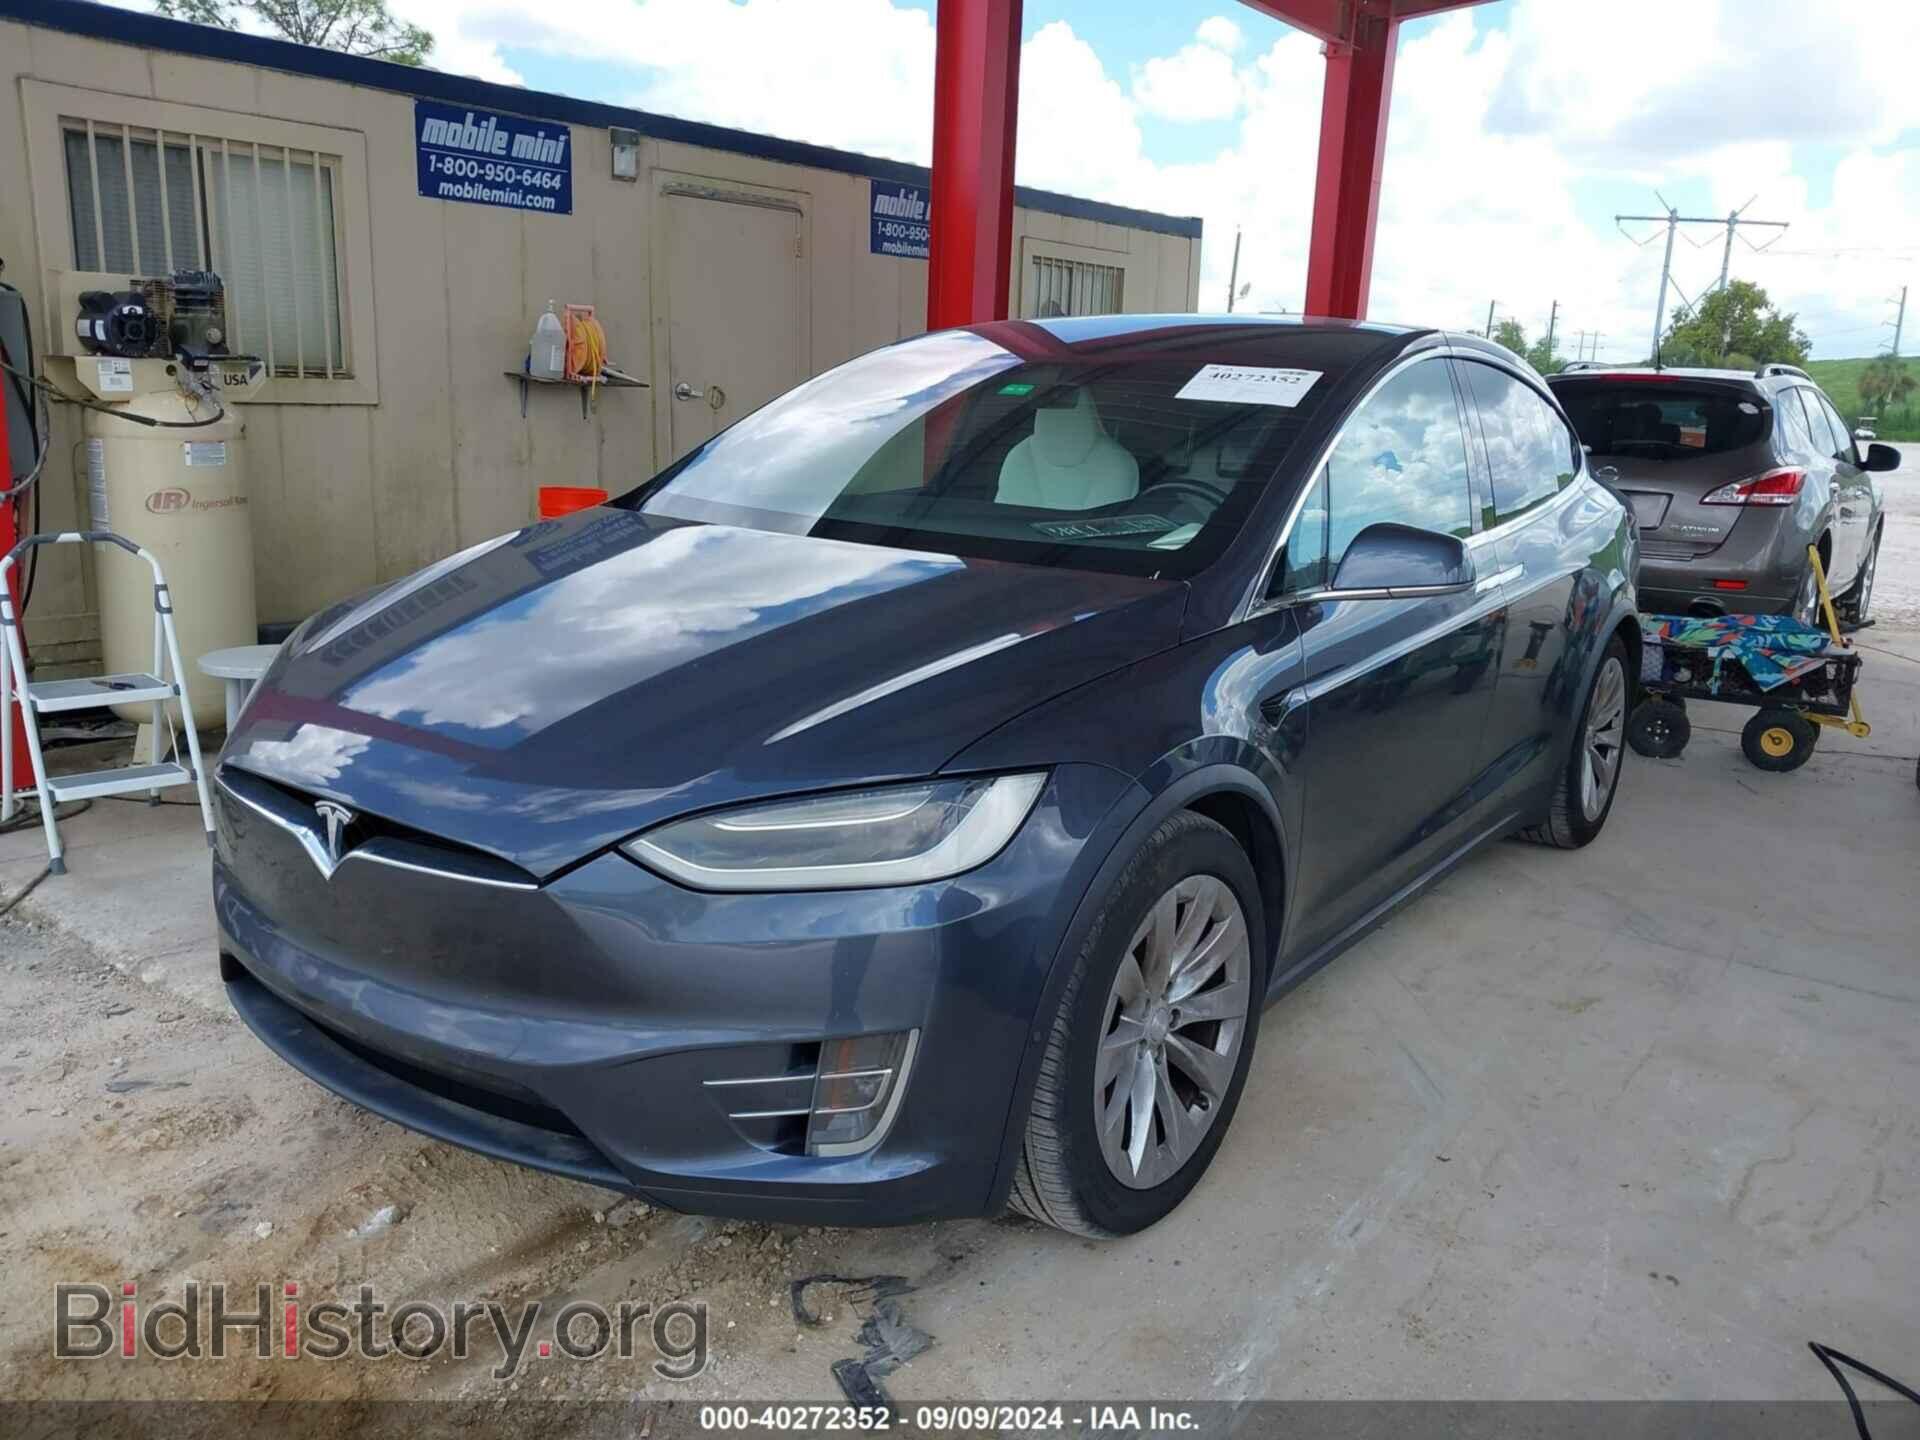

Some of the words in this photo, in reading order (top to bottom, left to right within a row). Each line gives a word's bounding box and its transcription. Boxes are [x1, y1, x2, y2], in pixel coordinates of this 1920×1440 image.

[421, 112, 509, 155] mobile
[511, 131, 567, 164] mini
[429, 155, 562, 191] 1-800-950-6464
[438, 182, 556, 210] mobilemini.com
[874, 188, 925, 220] mobile
[878, 221, 930, 241] 1-800-950-
[882, 241, 929, 257] mobilemin
[224, 374, 248, 386] USA
